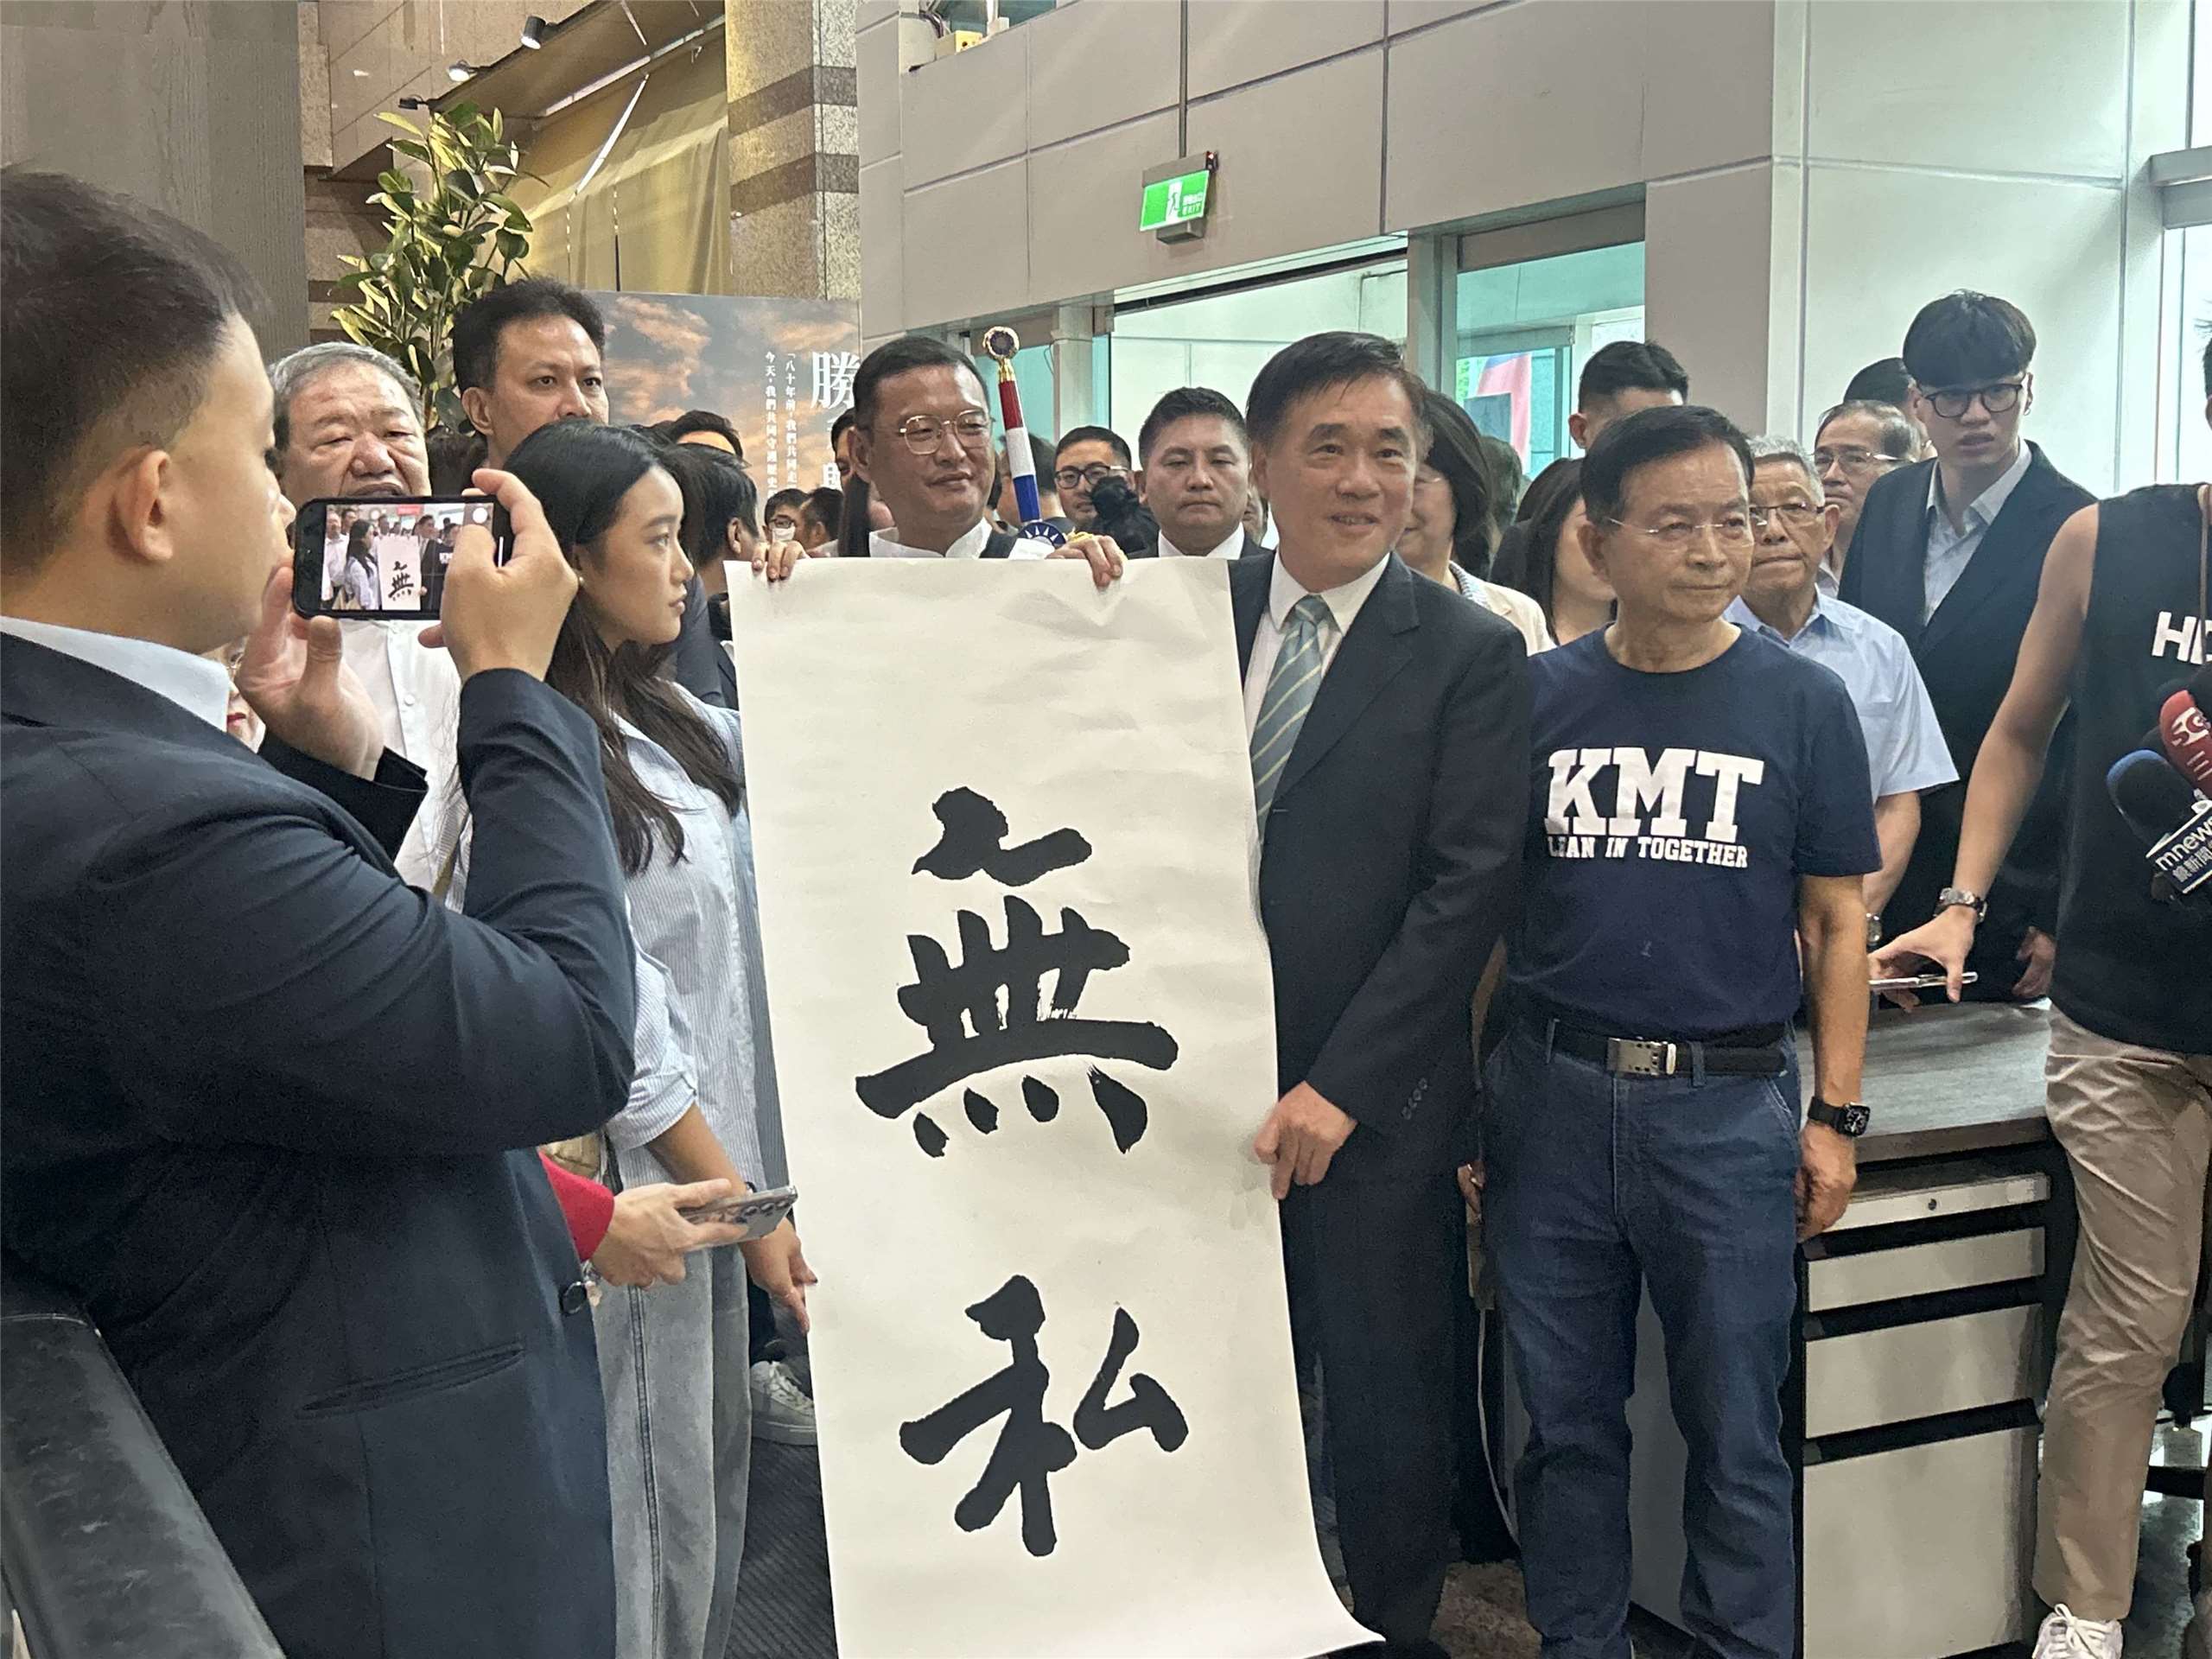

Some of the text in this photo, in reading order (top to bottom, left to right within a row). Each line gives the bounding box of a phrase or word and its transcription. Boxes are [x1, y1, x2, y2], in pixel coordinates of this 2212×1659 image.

[1544, 747, 1765, 843] KMT
[1605, 837, 1629, 858] IN
[1637, 836, 1749, 868] TOGETHER
[855, 785, 1190, 1558] 無私
